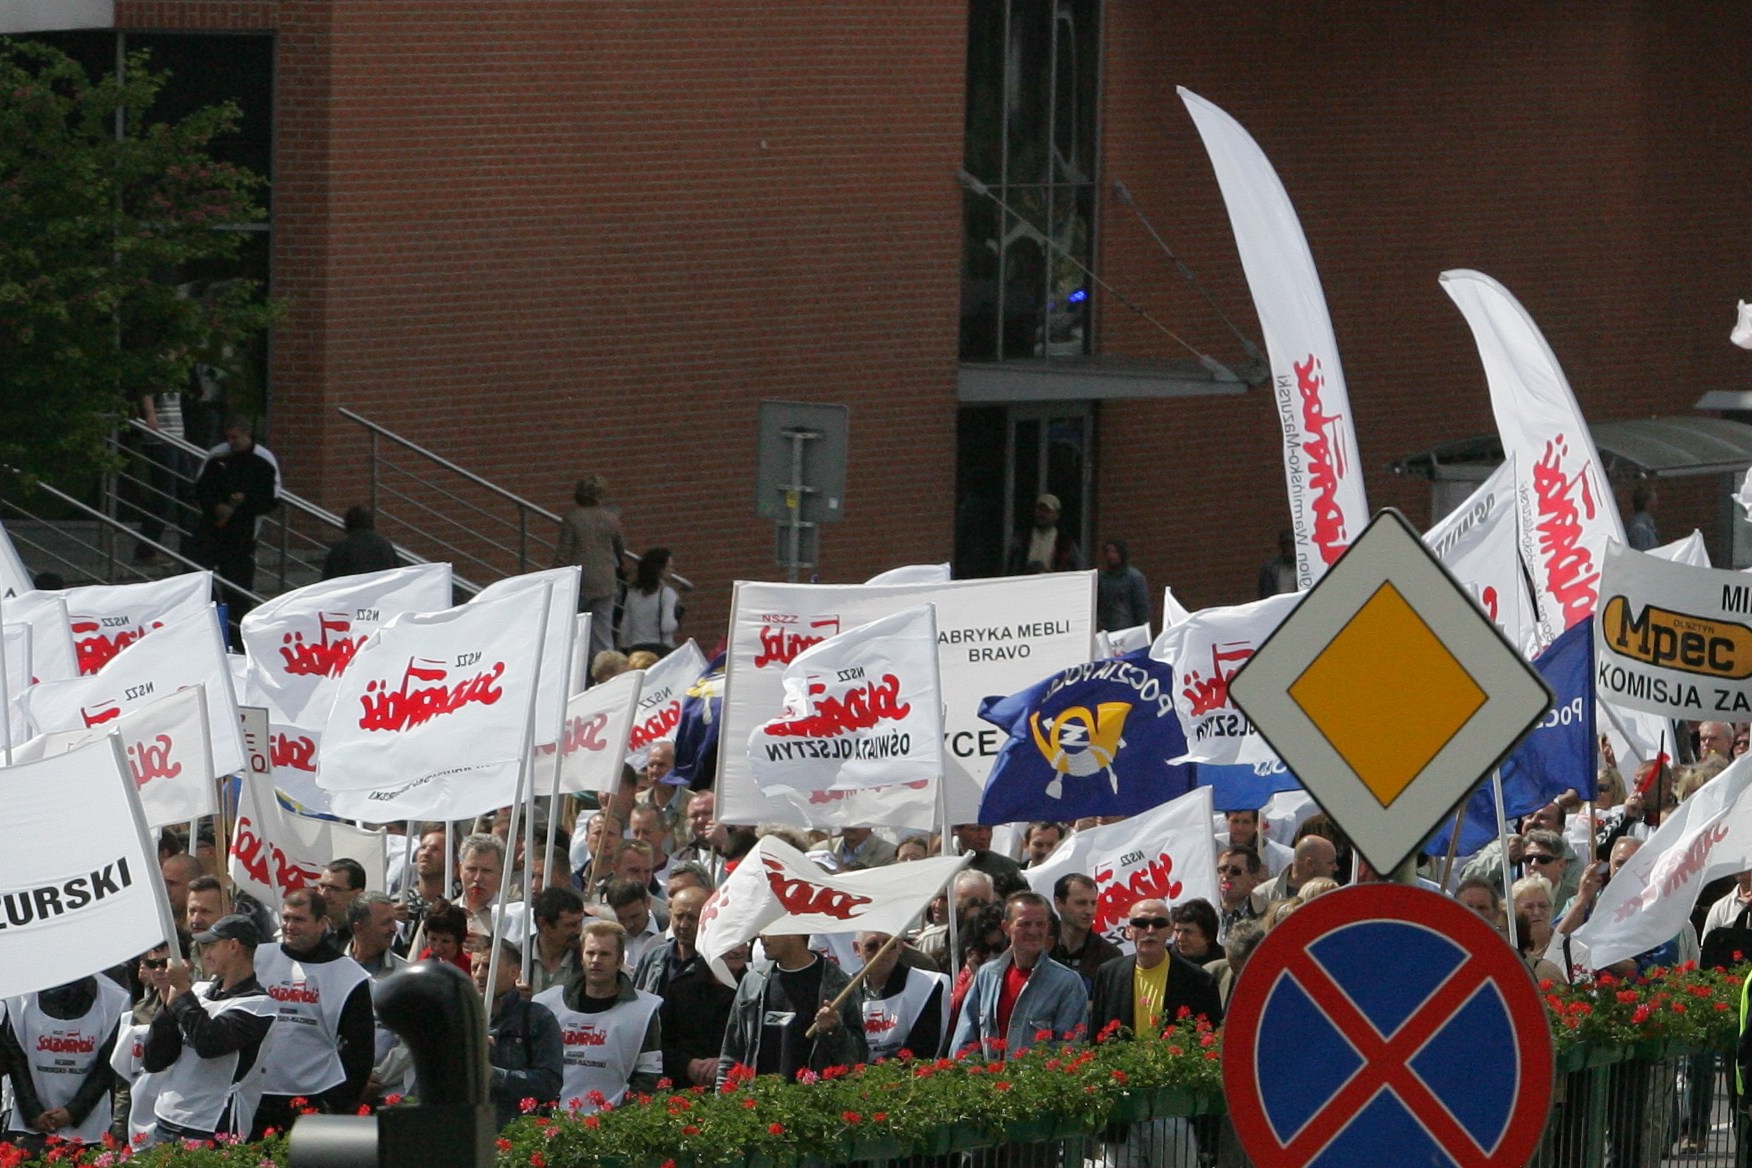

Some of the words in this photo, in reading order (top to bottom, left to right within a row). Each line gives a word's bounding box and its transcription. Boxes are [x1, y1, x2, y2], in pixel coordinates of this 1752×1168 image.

[1721, 584, 1752, 615] MI
[761, 614, 799, 624] NSZZ
[1017, 620, 1071, 638] MEBLI
[968, 644, 1031, 662] BRAVO
[1598, 660, 1702, 709] KOMISJA
